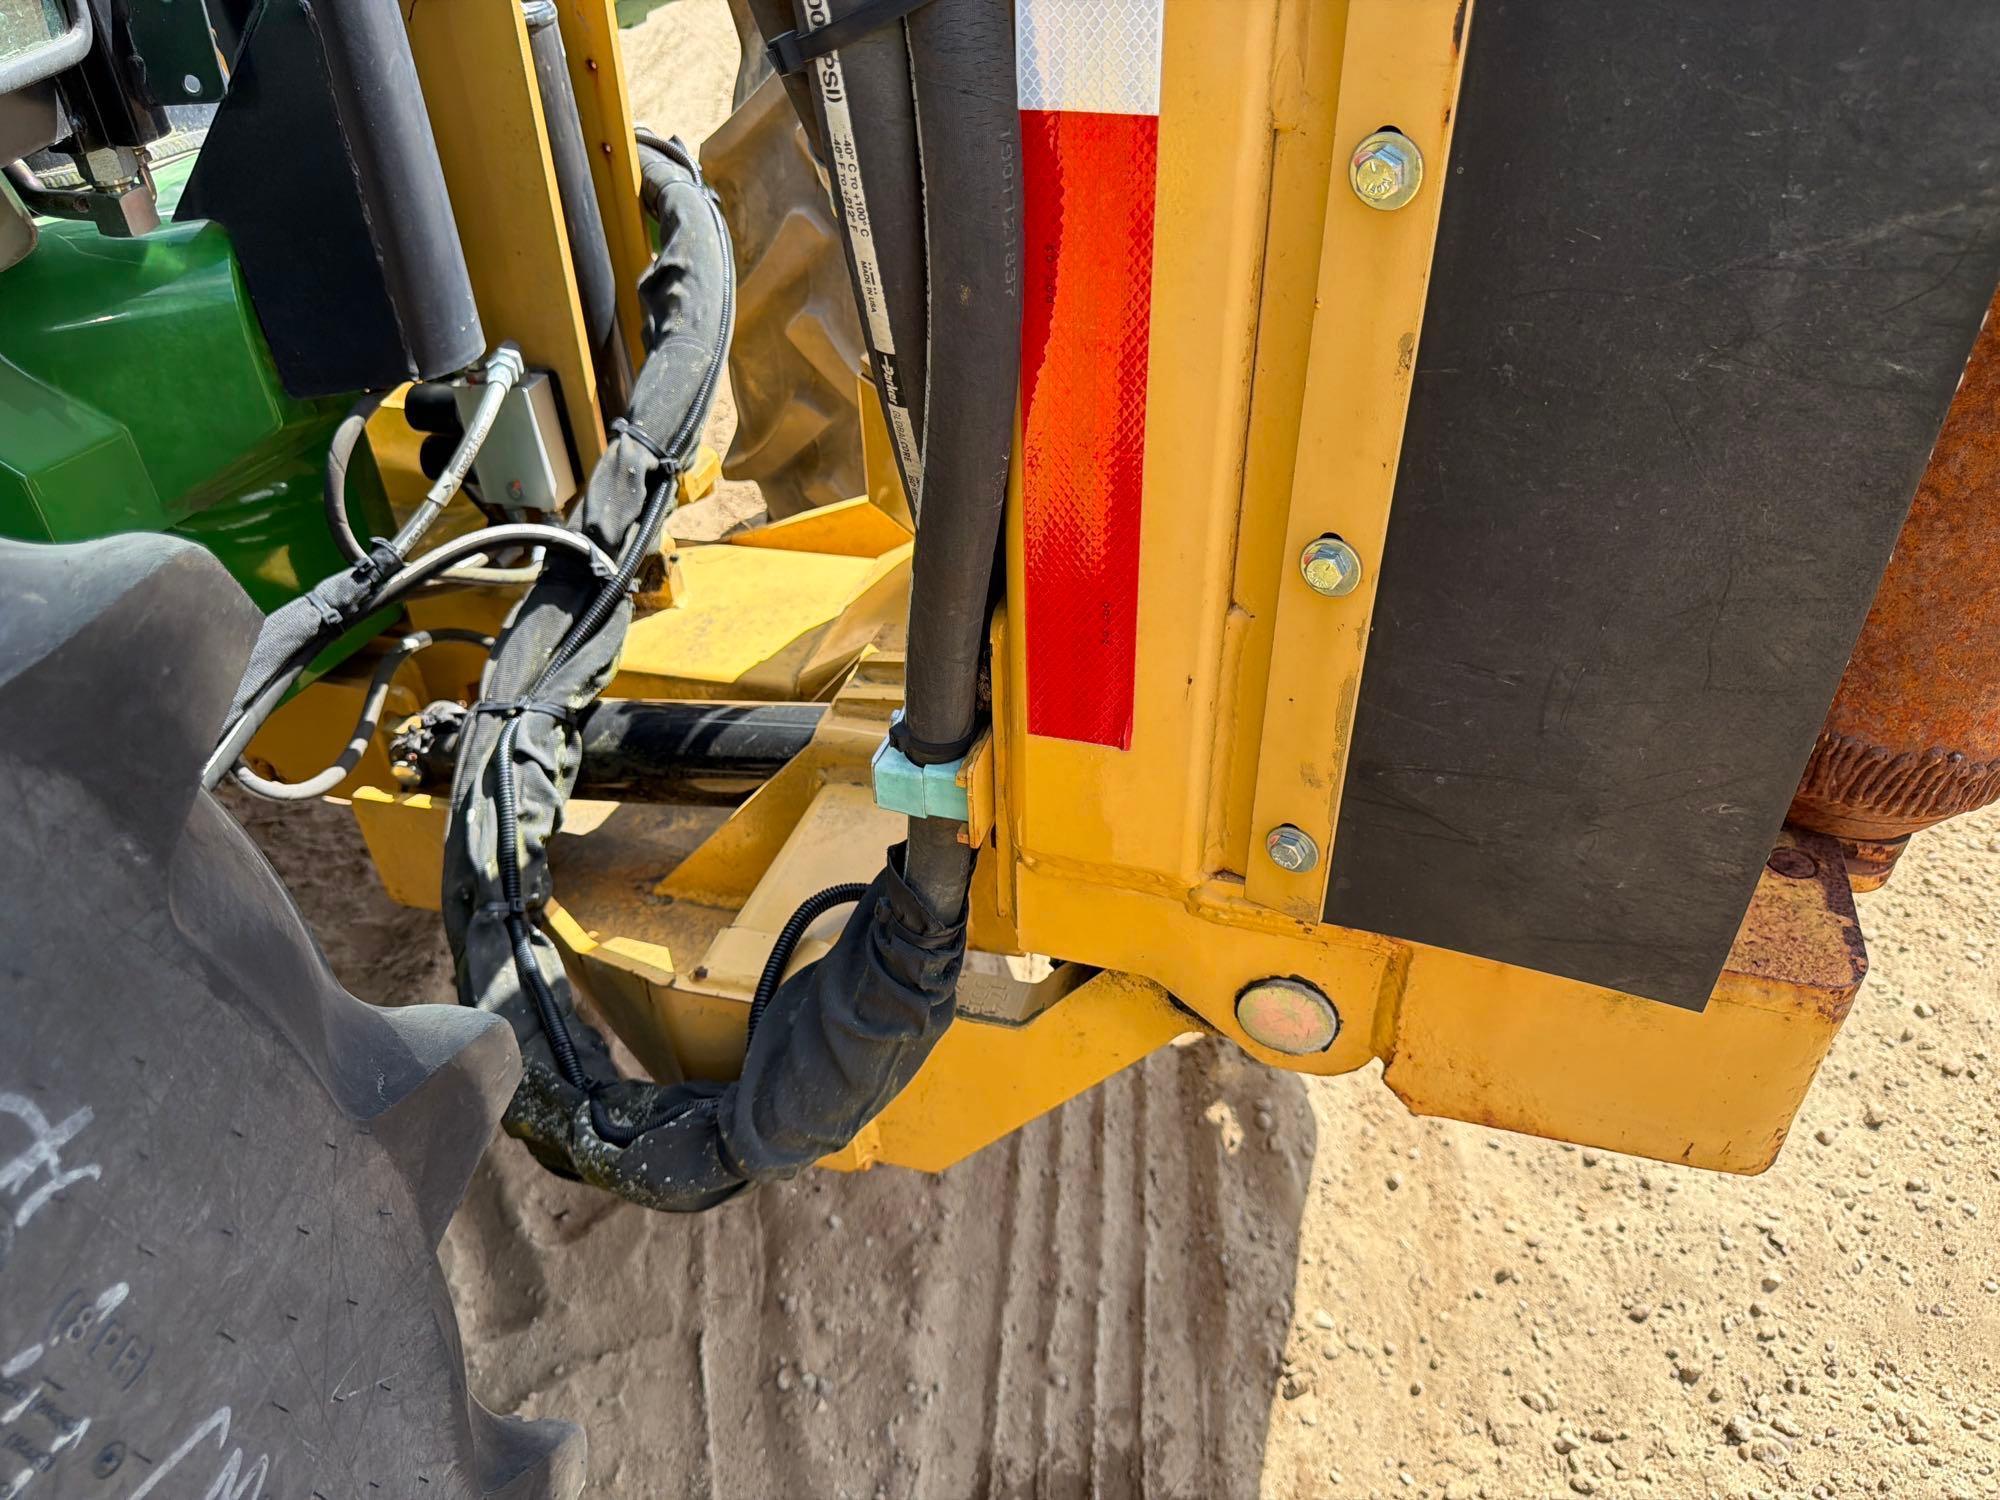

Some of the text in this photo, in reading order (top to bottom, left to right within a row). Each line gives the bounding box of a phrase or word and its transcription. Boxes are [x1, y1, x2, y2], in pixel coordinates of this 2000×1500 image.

[822, 52, 842, 103] PSI)
[838, 162, 846, 170] F
[848, 163, 857, 173] C
[840, 173, 847, 186] TO
[850, 176, 859, 190] TO
[850, 225, 858, 233] F
[860, 228, 870, 238] C
[861, 260, 877, 313] MADE IN USA
[881, 355, 898, 405] Parker
